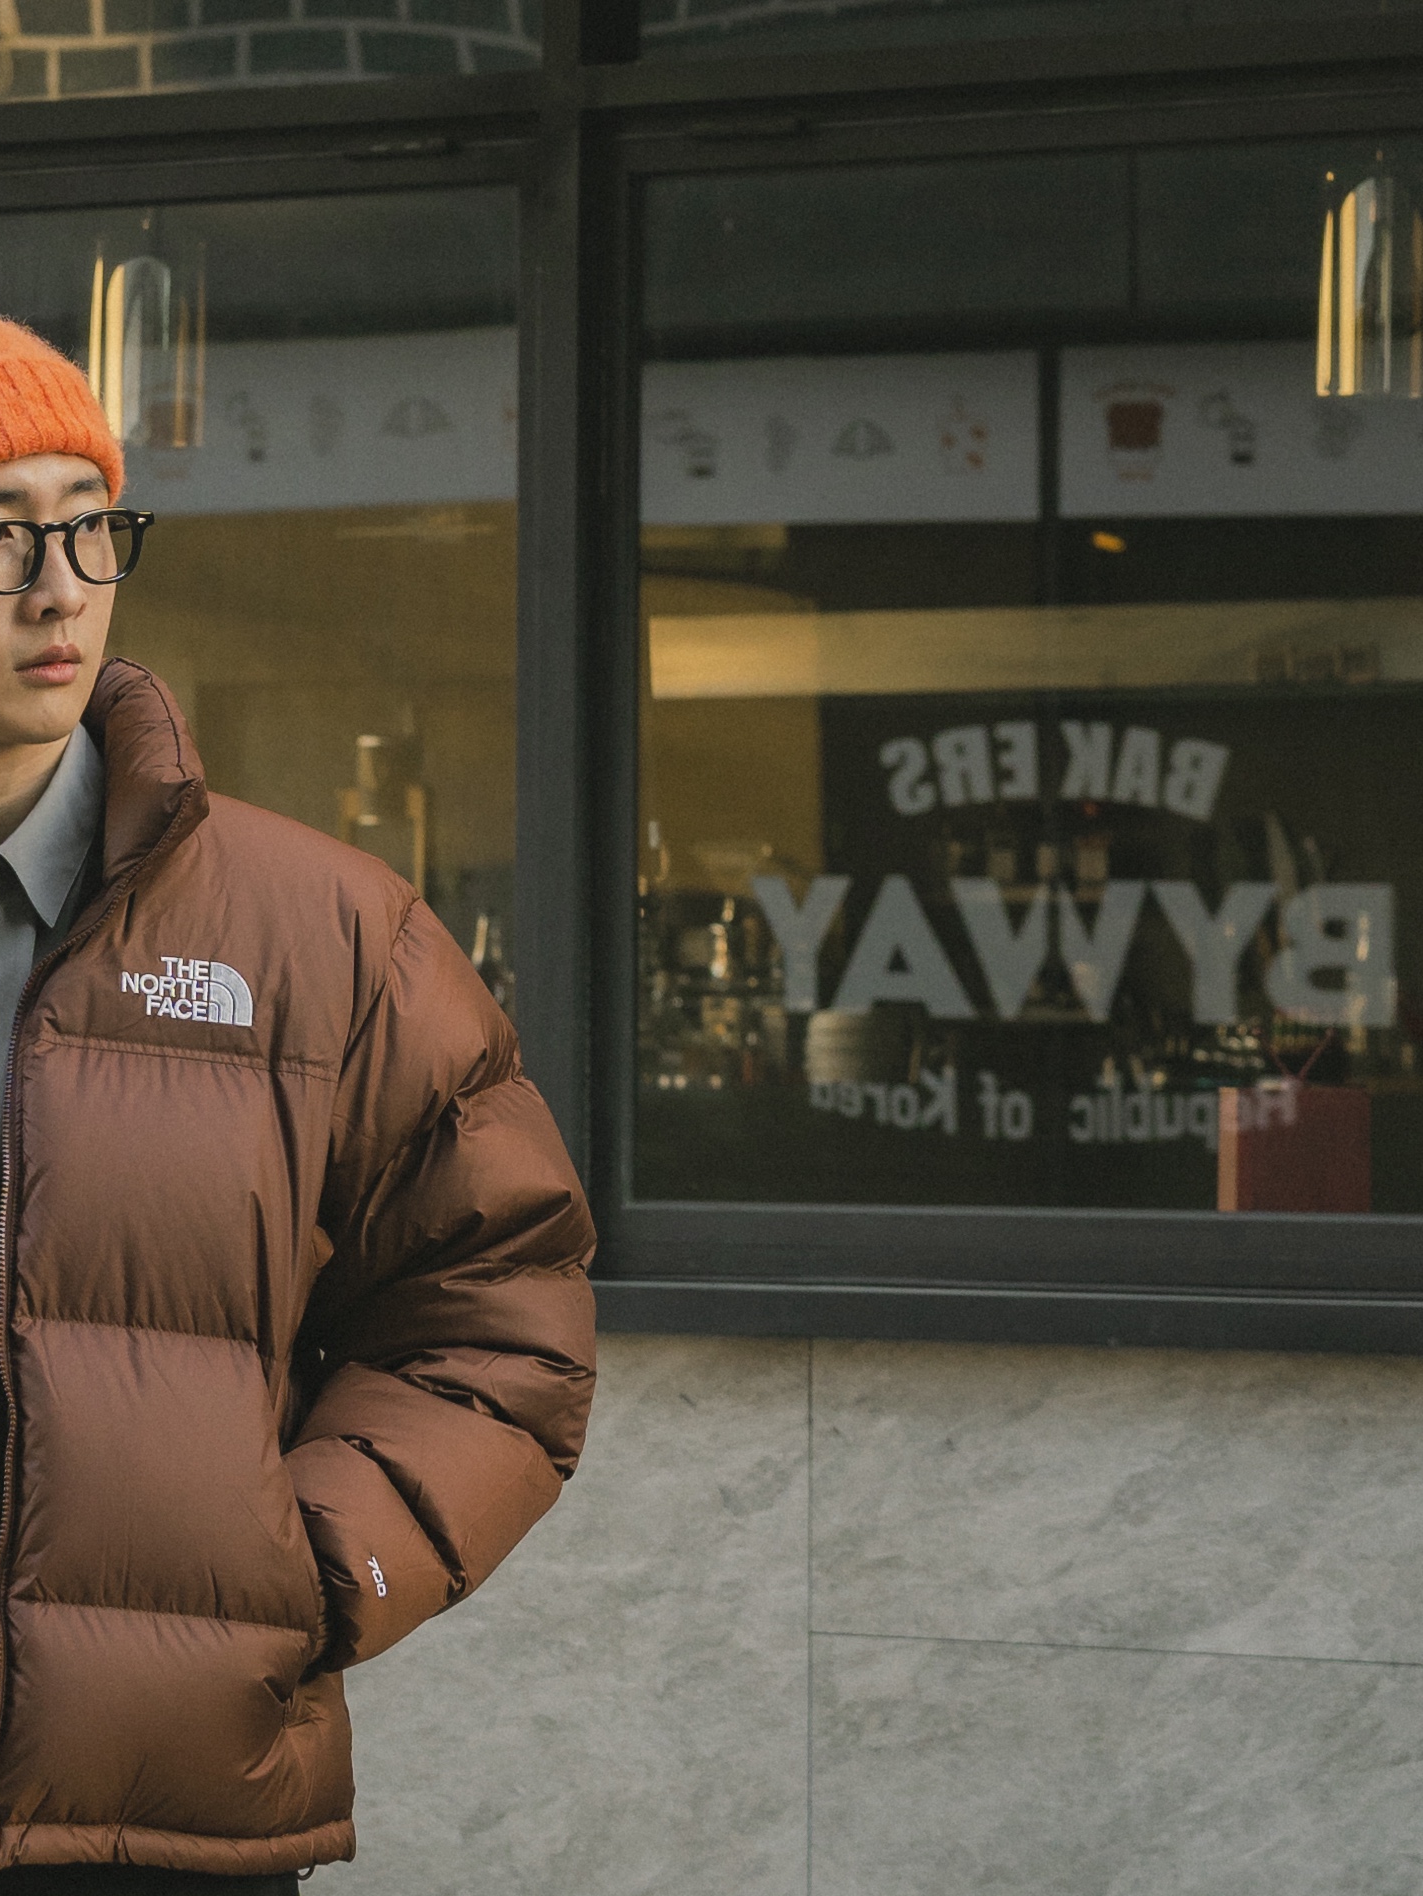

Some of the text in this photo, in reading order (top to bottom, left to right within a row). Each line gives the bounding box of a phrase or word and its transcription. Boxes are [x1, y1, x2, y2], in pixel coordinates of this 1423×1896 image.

[160, 956, 210, 981] THE
[121, 971, 208, 1001] NORTH
[146, 995, 208, 1022] FACE
[367, 1556, 387, 1597] 700
